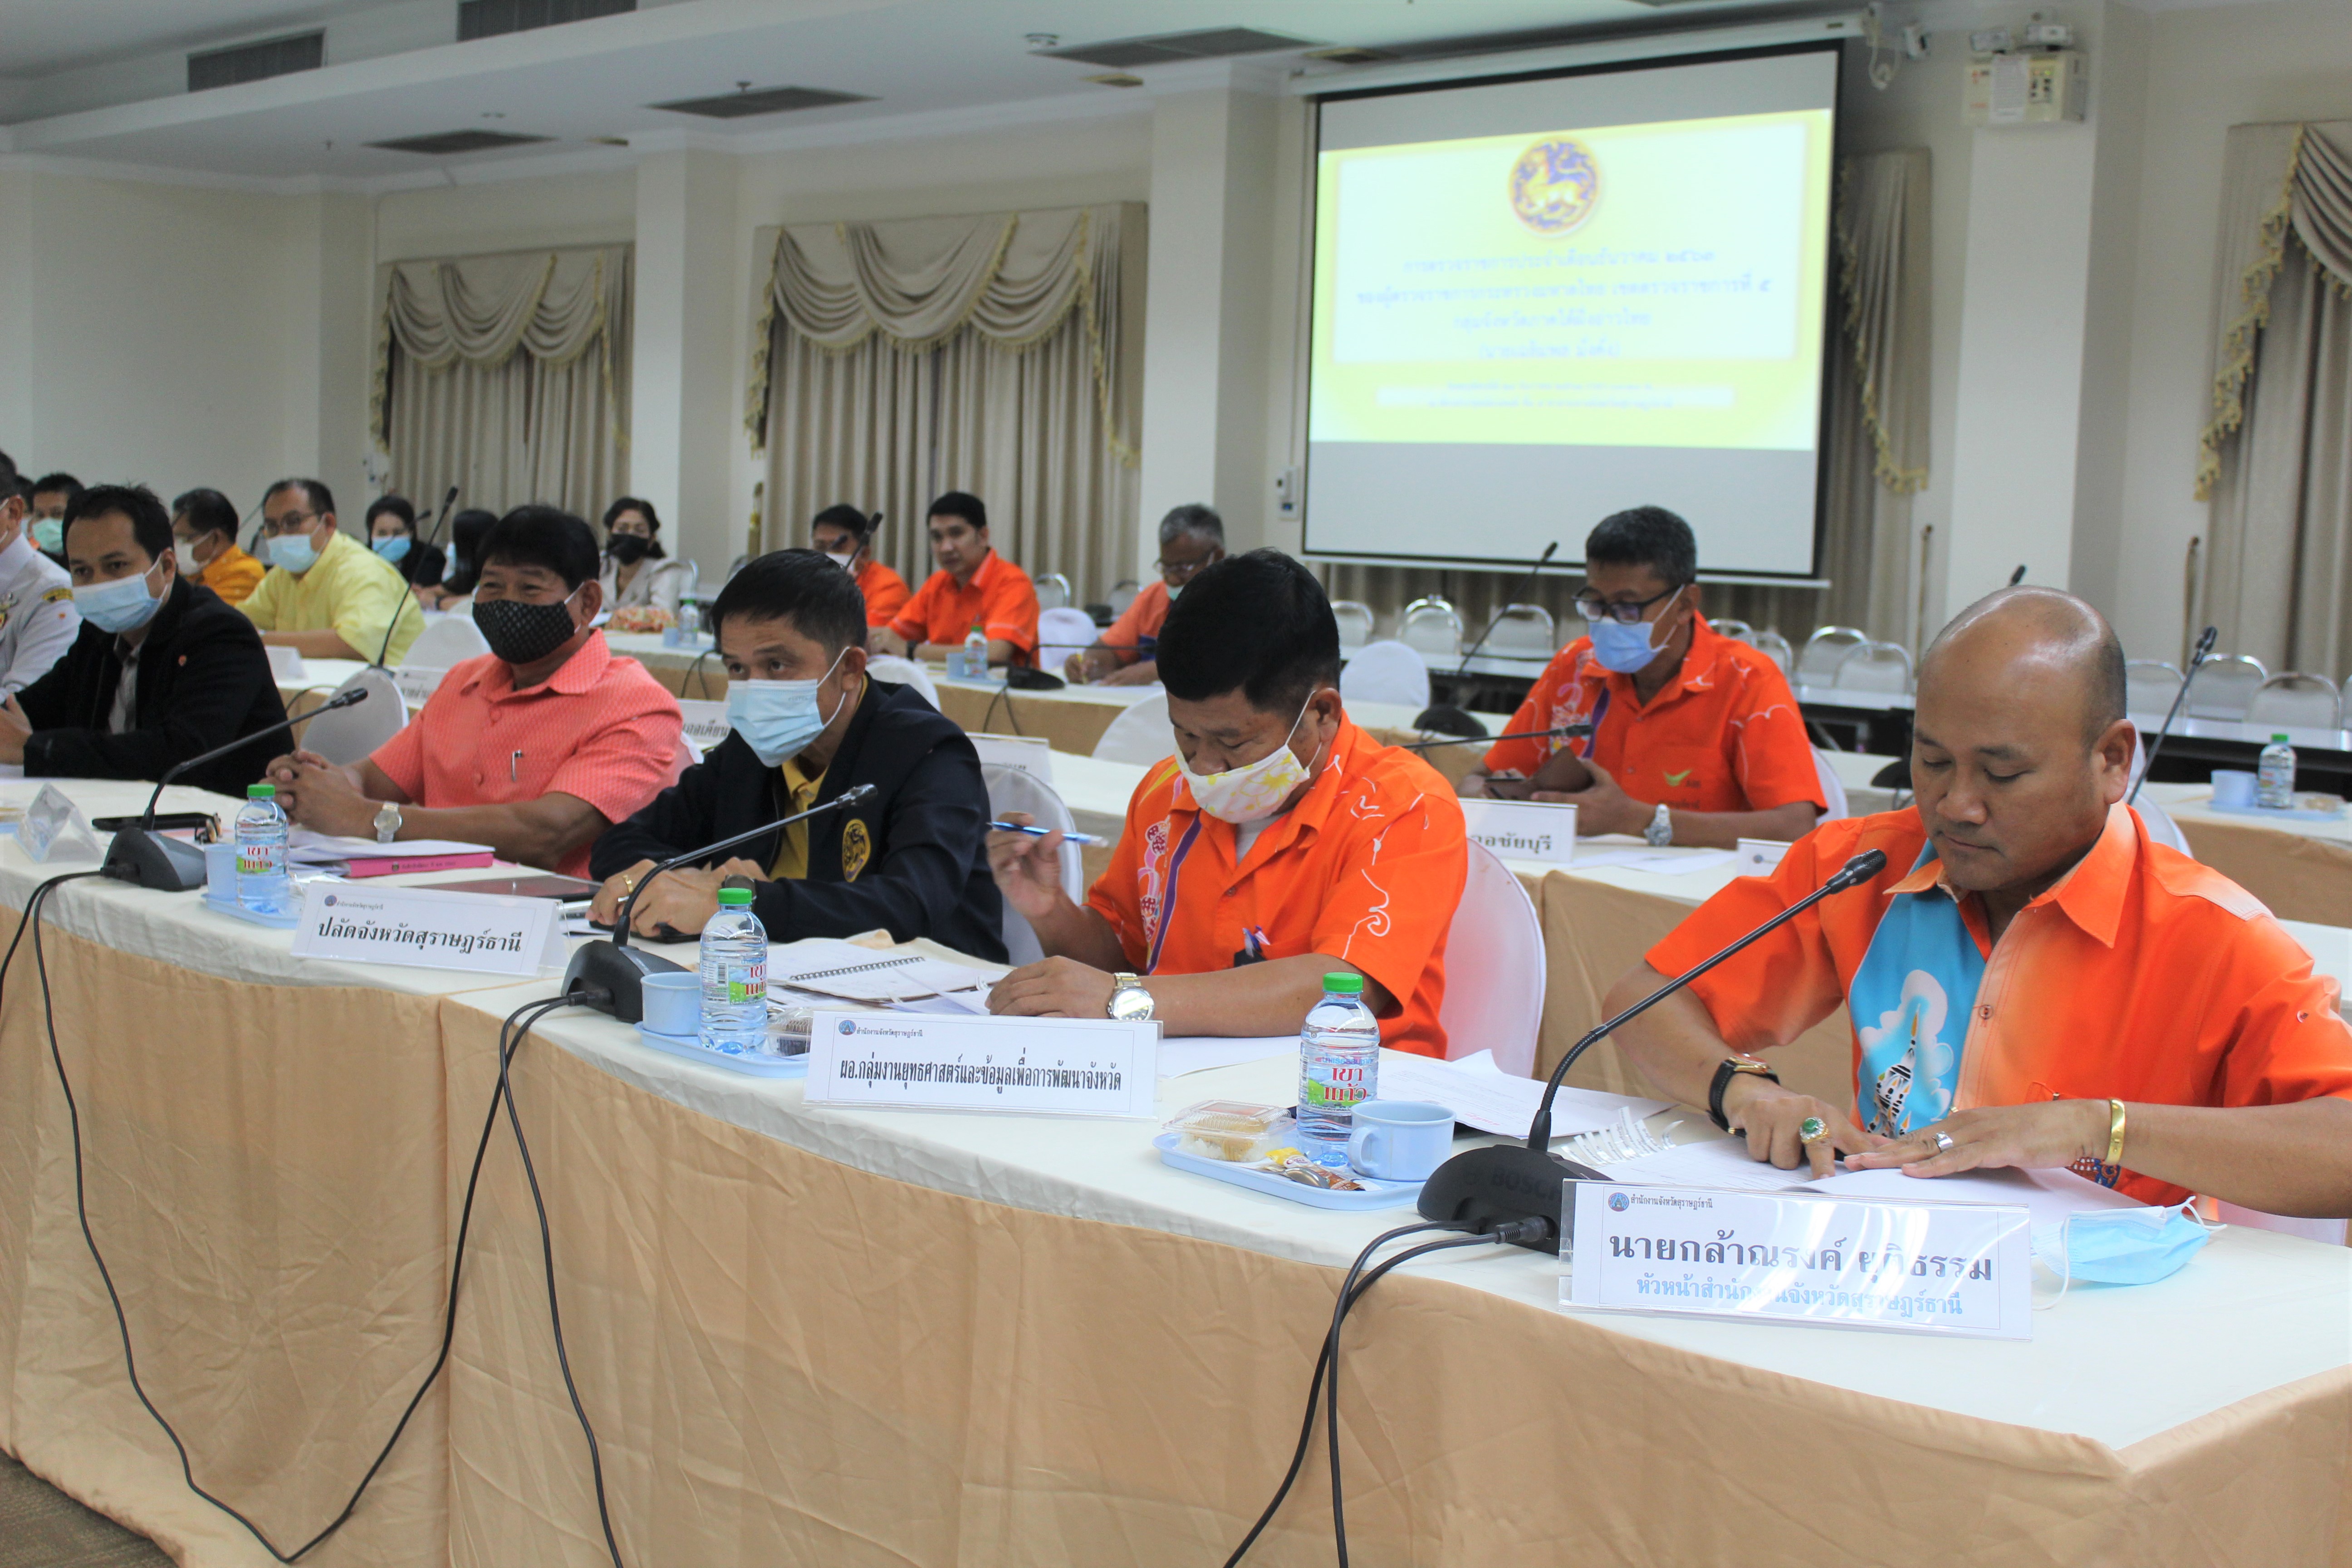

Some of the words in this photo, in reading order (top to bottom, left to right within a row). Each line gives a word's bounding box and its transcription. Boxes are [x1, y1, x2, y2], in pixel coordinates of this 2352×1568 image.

[318, 916, 522, 954] ปลัดจังหวัดสุราษฎร์ธานี
[745, 978, 766, 995] แก้
[856, 1027, 923, 1039] สำนักงานจังหวัดสุราษฎร์ธานี
[840, 1047, 1122, 1094] ผอ.กลุ่มงานยุทธศาสตร์และข้อมูลเพื่อการพัฒนาจังหวัด
[1332, 1068, 1363, 1082] เขา
[1324, 1083, 1367, 1102] แก้ว
[1631, 1194, 1713, 1210] สำนักงานจังหวัดสุราษฎร์ธานี
[1609, 1229, 1847, 1271] นายกล้าณรงค์
